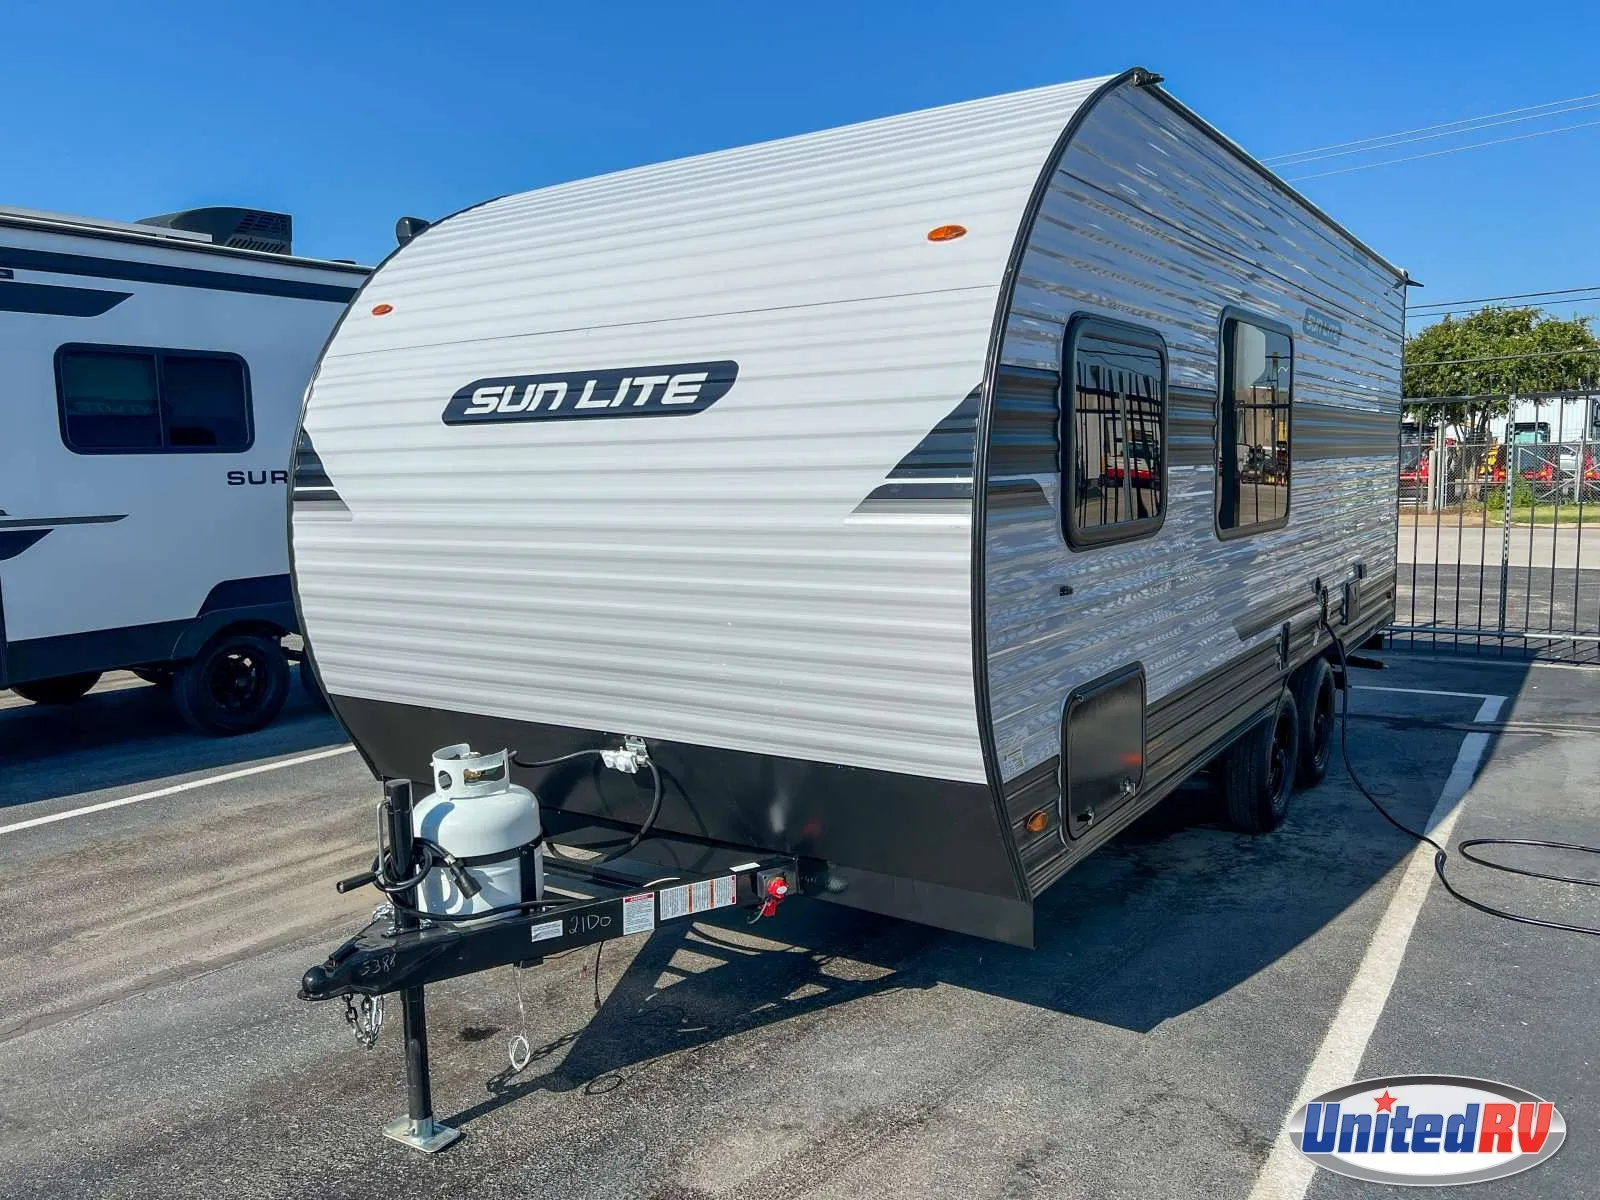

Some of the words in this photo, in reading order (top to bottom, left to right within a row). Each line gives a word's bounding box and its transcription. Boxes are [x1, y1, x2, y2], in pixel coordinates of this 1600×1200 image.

[463, 382, 568, 415] SUN
[574, 372, 709, 410] LITE
[227, 470, 288, 486] SUR
